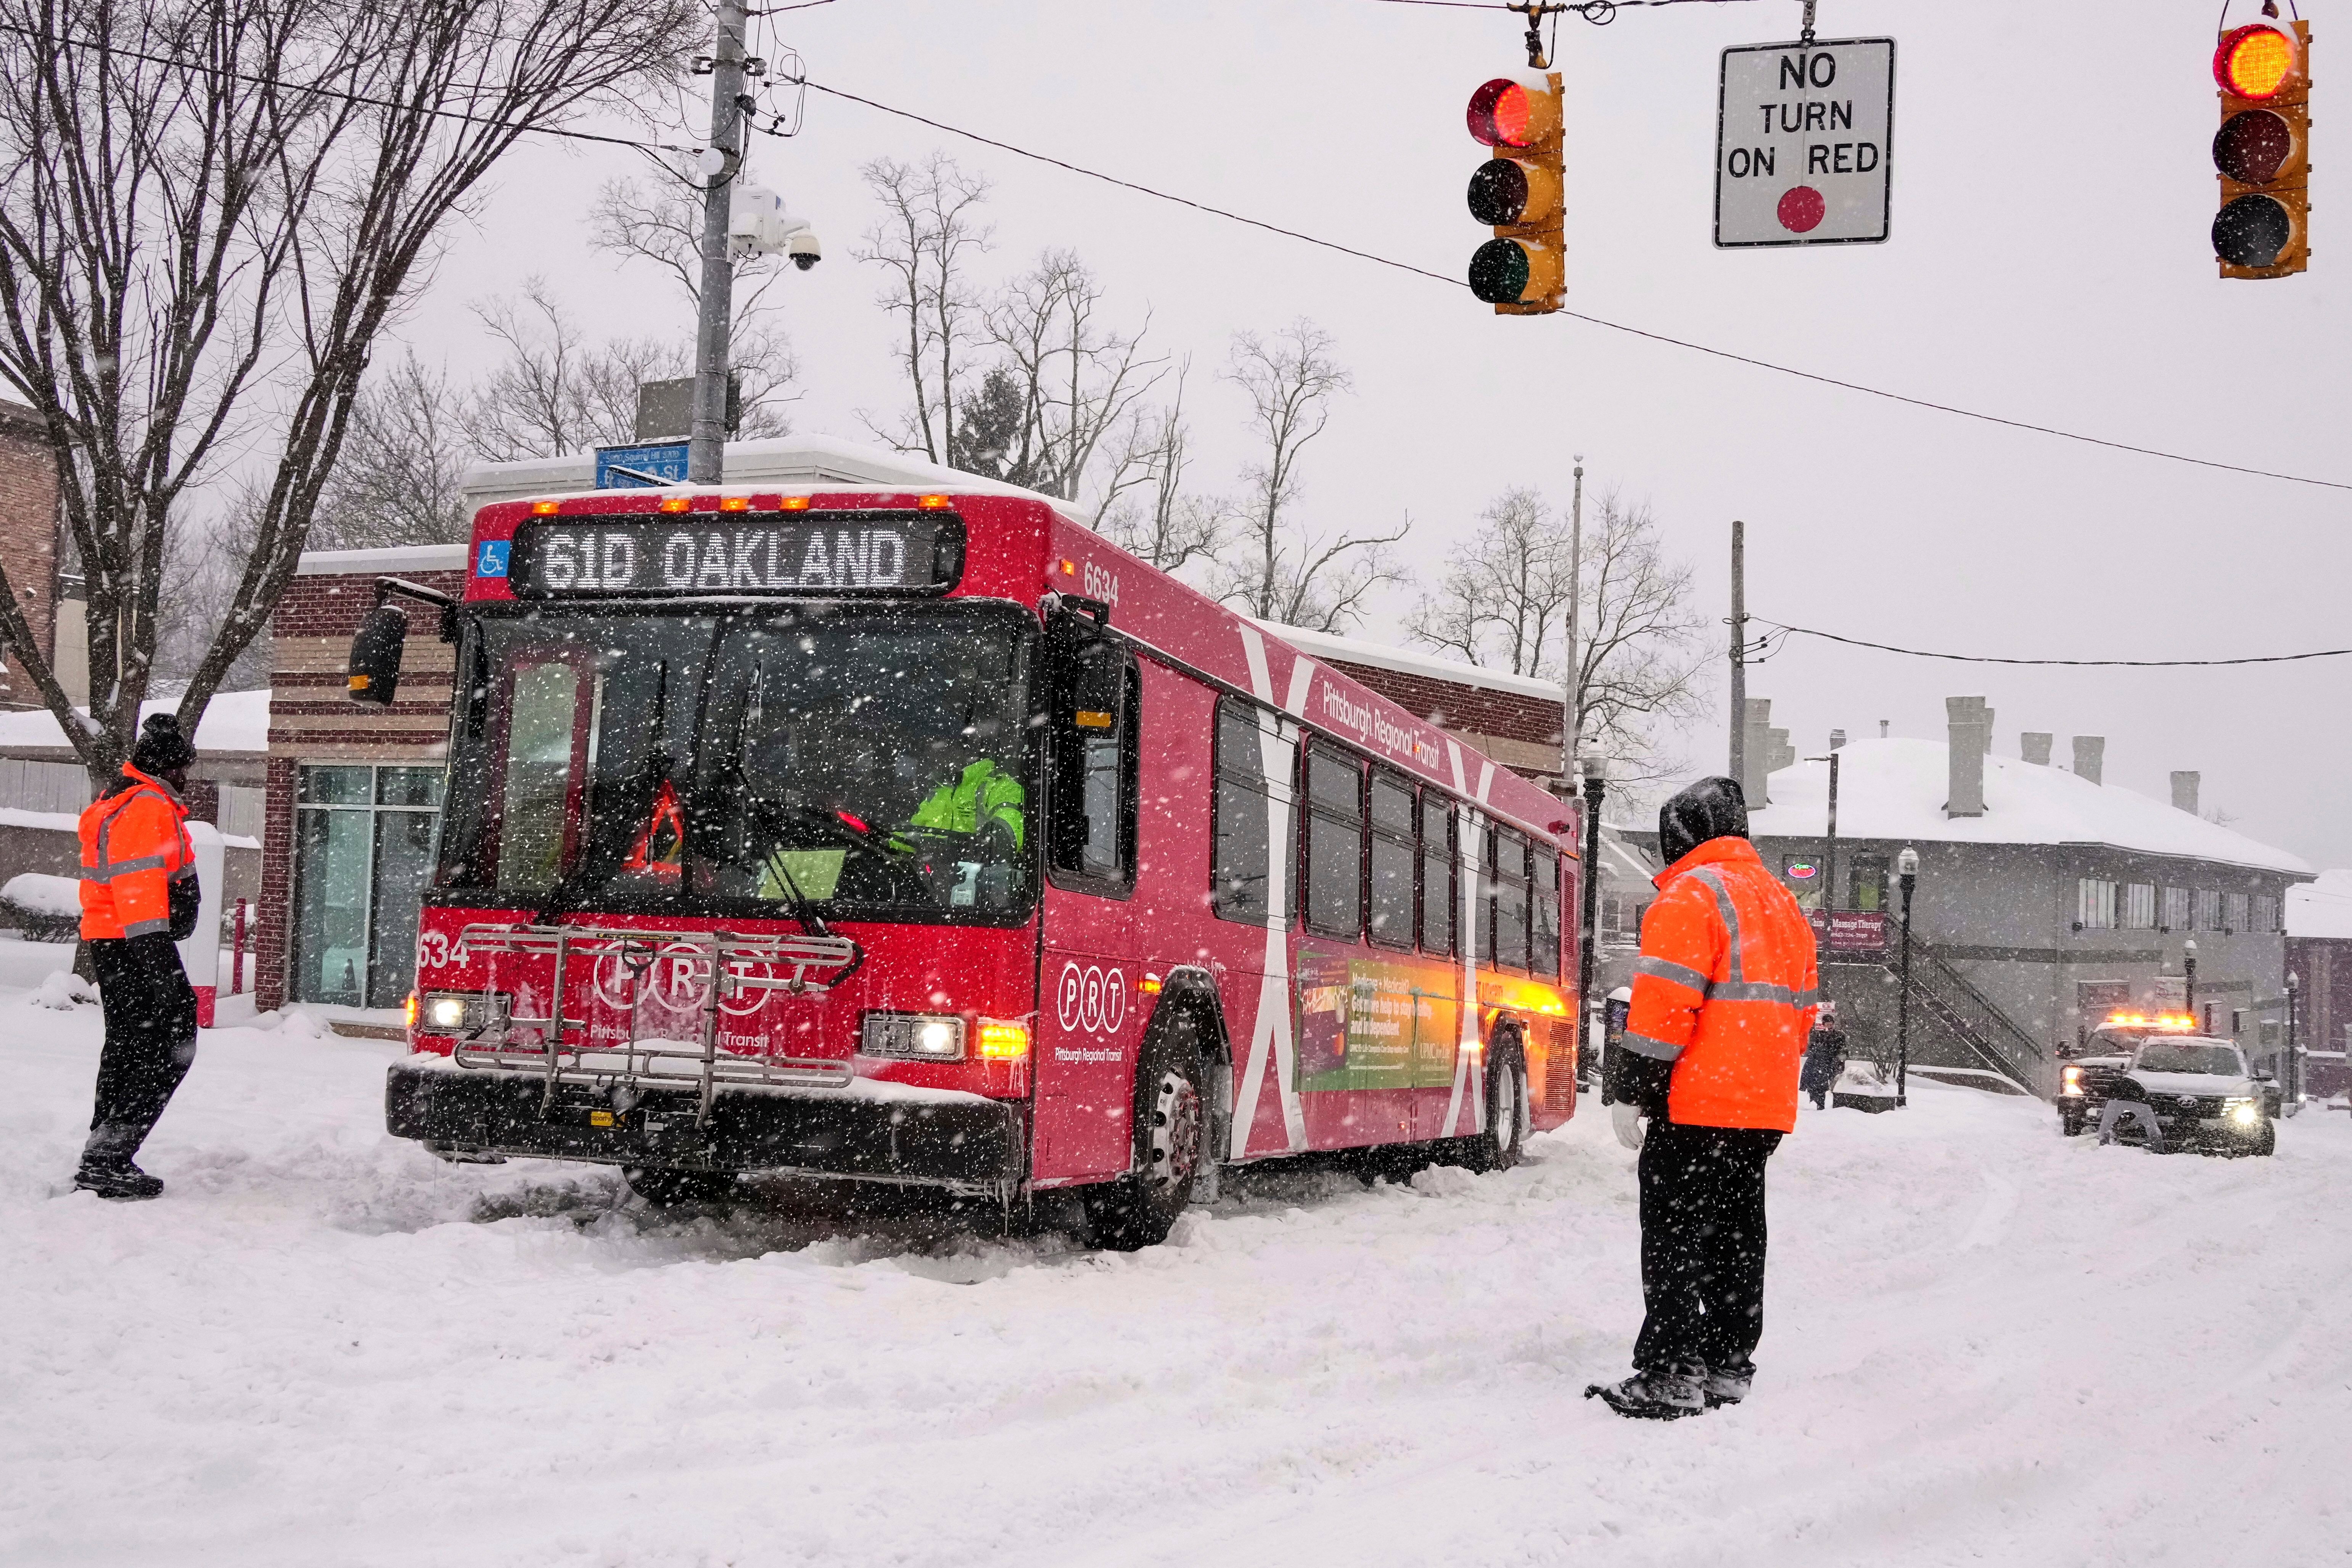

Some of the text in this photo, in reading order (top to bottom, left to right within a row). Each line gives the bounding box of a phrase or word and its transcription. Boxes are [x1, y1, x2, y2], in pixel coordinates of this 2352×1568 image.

[1780, 52, 1836, 90] NO
[1758, 100, 1852, 133] TURN
[1728, 142, 1879, 178] ON RED
[664, 465, 679, 480] St
[544, 529, 904, 589] 61D OAKLAND
[1084, 561, 1118, 608] 6634
[1323, 681, 1439, 770] Pittsburgh Regional Transit
[1832, 918, 1857, 931] Massage
[1858, 920, 1882, 931] Therapy
[419, 933, 470, 968] 634
[1352, 994, 1363, 1012] Get
[1380, 996, 1392, 1018] help
[1393, 999, 1399, 1016] to
[1400, 1001, 1412, 1019] stay
[724, 1031, 769, 1047] Transit
[1351, 1016, 1400, 1038] and independent
[1055, 1047, 1122, 1065] Pittsburgh Regional Transit
